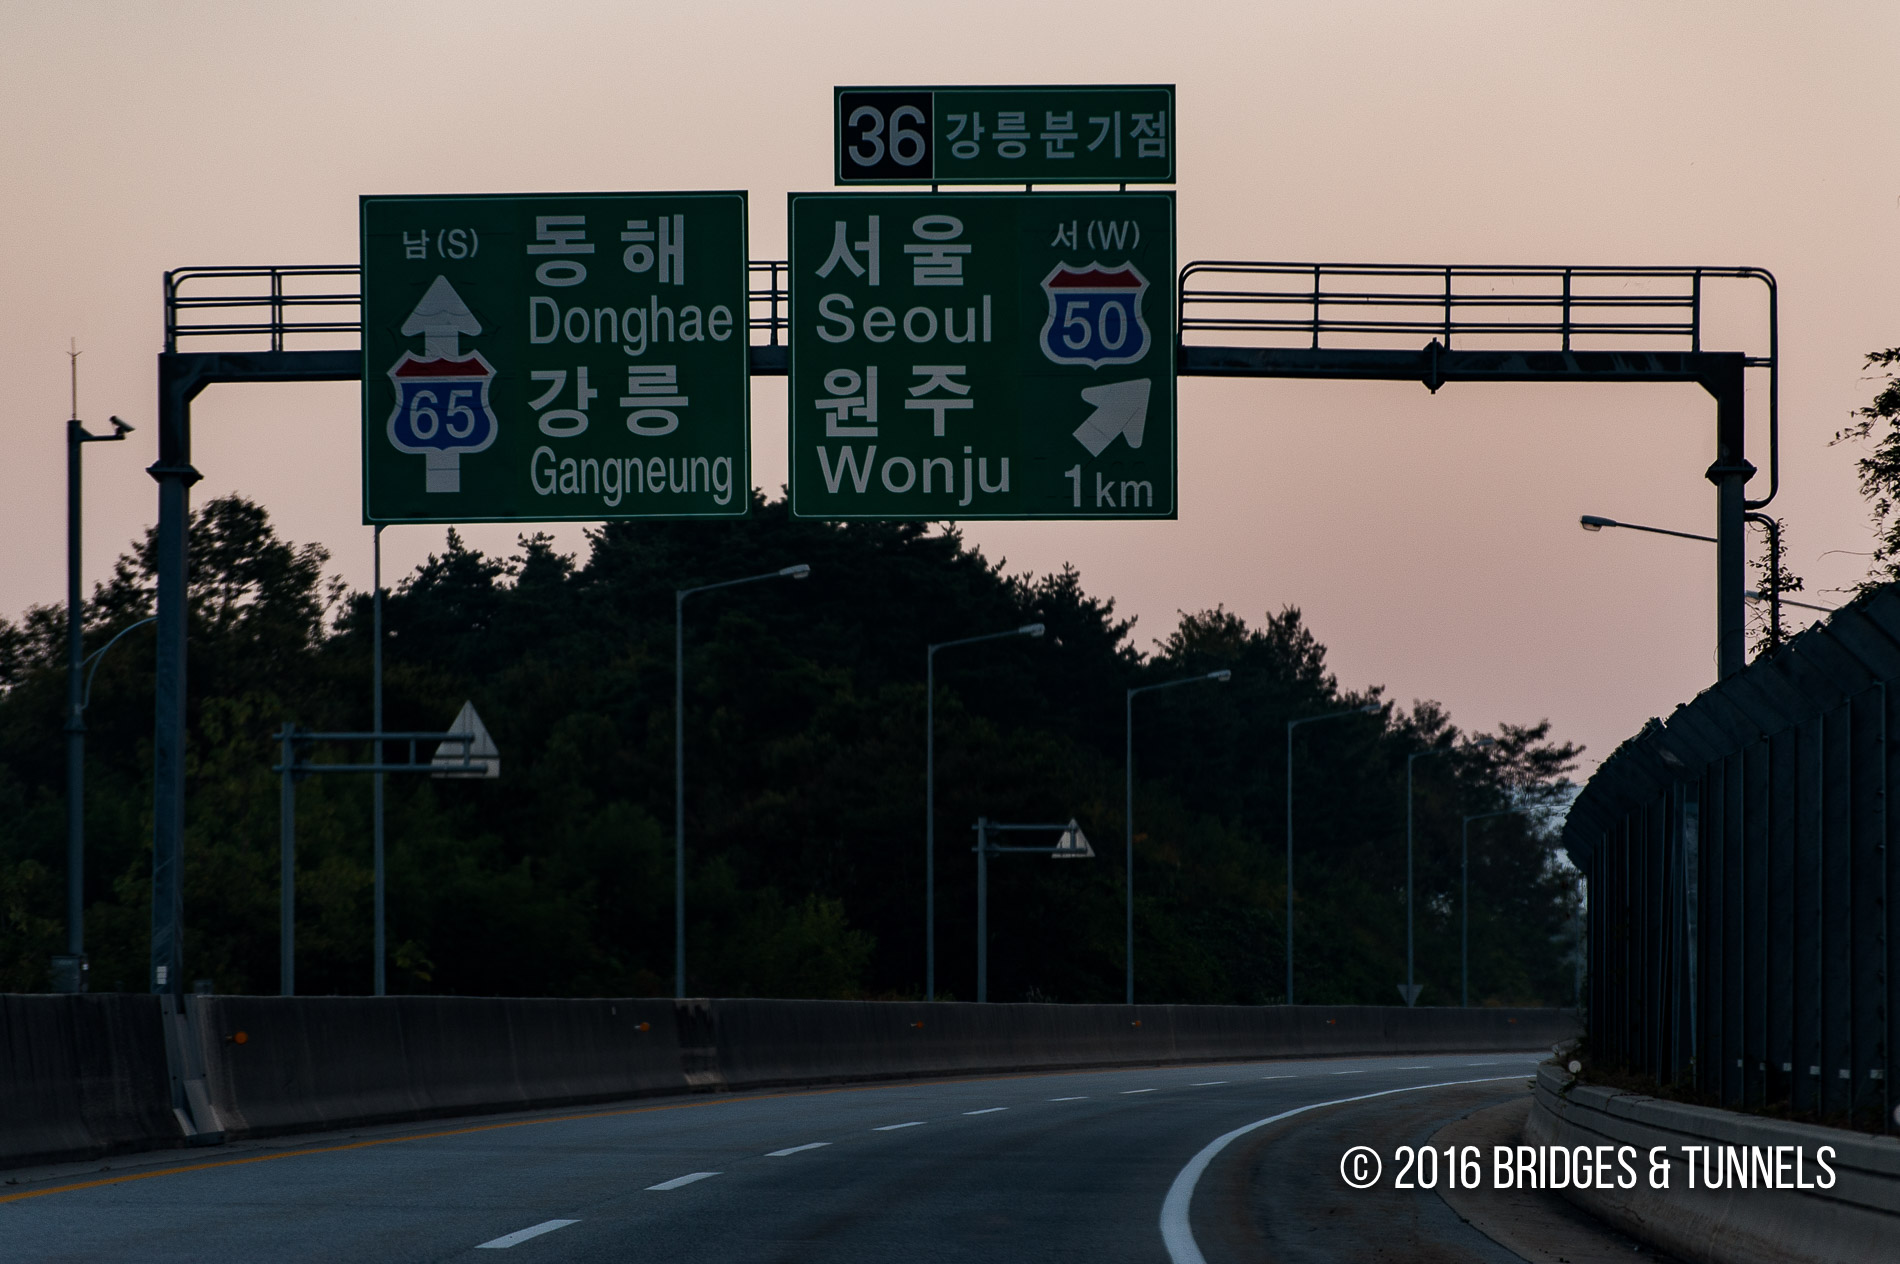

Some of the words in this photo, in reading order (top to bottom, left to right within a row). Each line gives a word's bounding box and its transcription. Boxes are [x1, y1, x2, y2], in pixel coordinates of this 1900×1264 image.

[848, 105, 926, 166] 36
[945, 110, 1166, 158] 강릉분기점
[526, 214, 685, 287] 동해
[815, 214, 972, 286] 서울
[529, 295, 733, 356] Donghae
[816, 293, 991, 343] Seoul
[1062, 300, 1127, 350] 50
[409, 389, 475, 439] 65
[528, 365, 688, 437] 강릉
[815, 365, 974, 437] 원주
[530, 445, 733, 507] Gangneung
[816, 445, 1010, 506] Wonju
